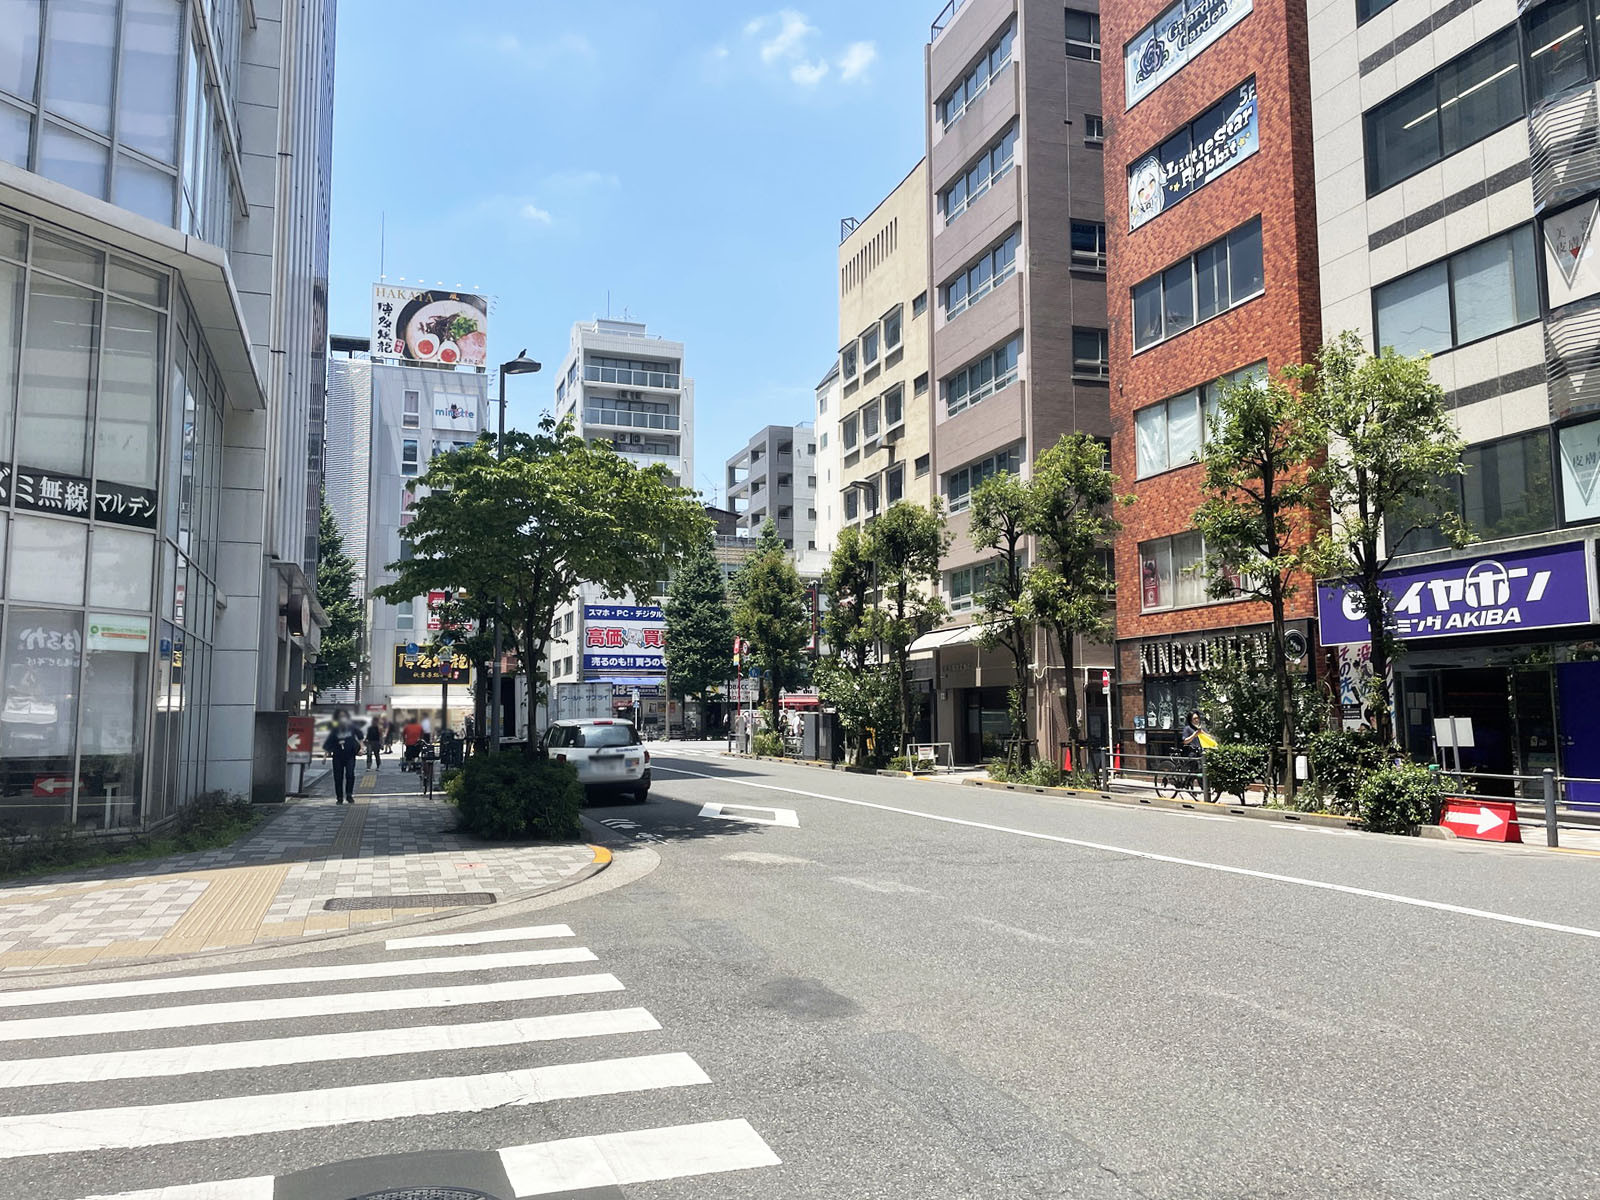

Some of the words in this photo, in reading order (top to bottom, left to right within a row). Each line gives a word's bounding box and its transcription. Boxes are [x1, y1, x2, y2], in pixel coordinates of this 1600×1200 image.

[1181, 139, 1237, 188] Rabbit
[375, 287, 434, 303] HAKATA
[95, 492, 157, 518] マルデン
[588, 608, 664, 618] スマホ・PC・デジタル
[1446, 607, 1522, 630] AKIBA
[586, 627, 623, 646] 高価
